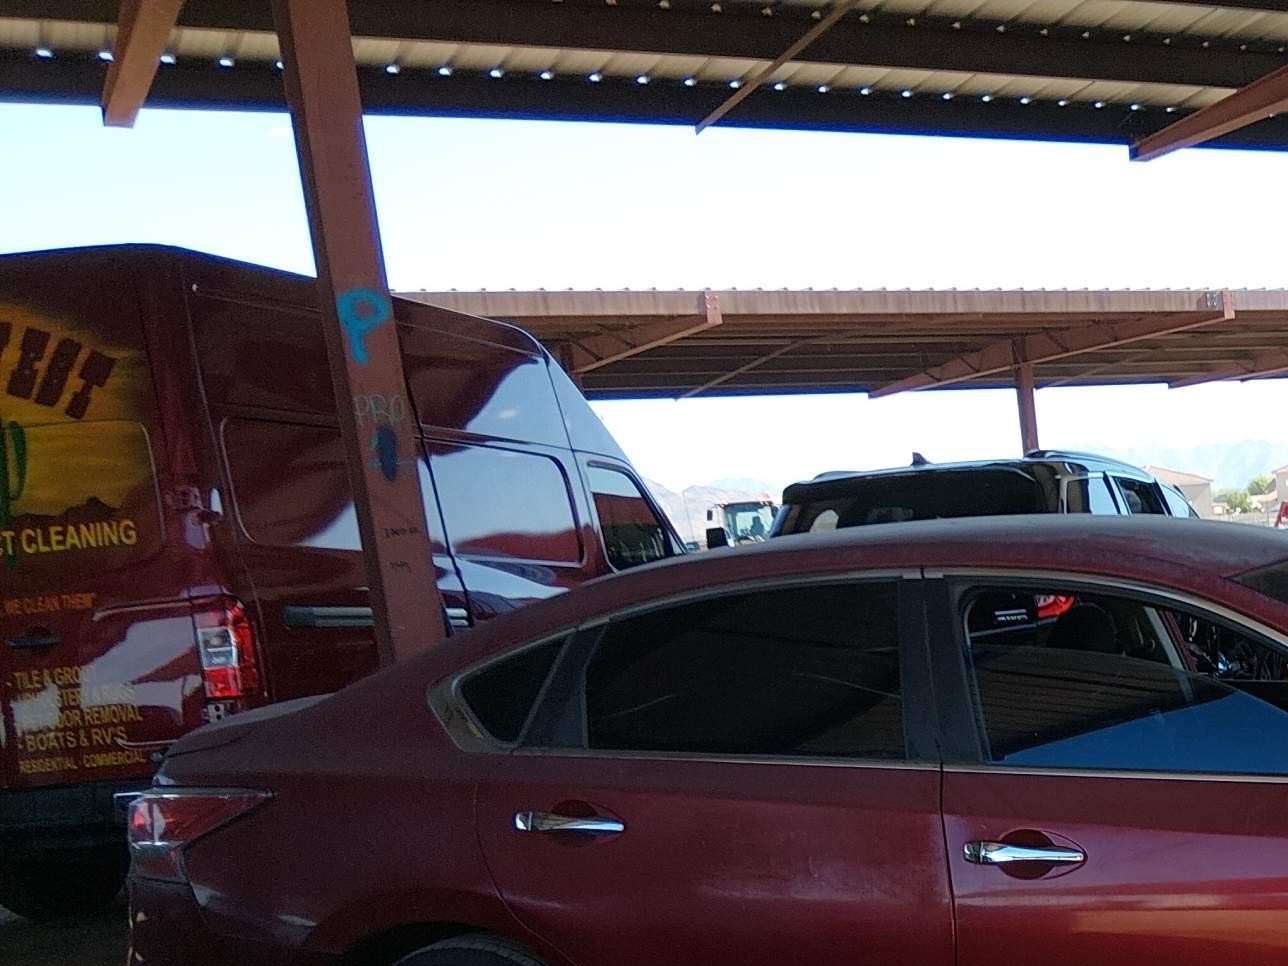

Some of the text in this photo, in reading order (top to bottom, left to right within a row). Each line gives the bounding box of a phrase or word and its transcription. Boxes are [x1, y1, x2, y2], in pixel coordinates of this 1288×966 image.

[337, 287, 393, 368] P
[21, 519, 138, 555] CLEANING
[14, 670, 42, 690] TILE
[83, 702, 144, 726] REMOVAL
[25, 731, 77, 753] BOATS
[82, 750, 147, 769] COMMERCIAL
